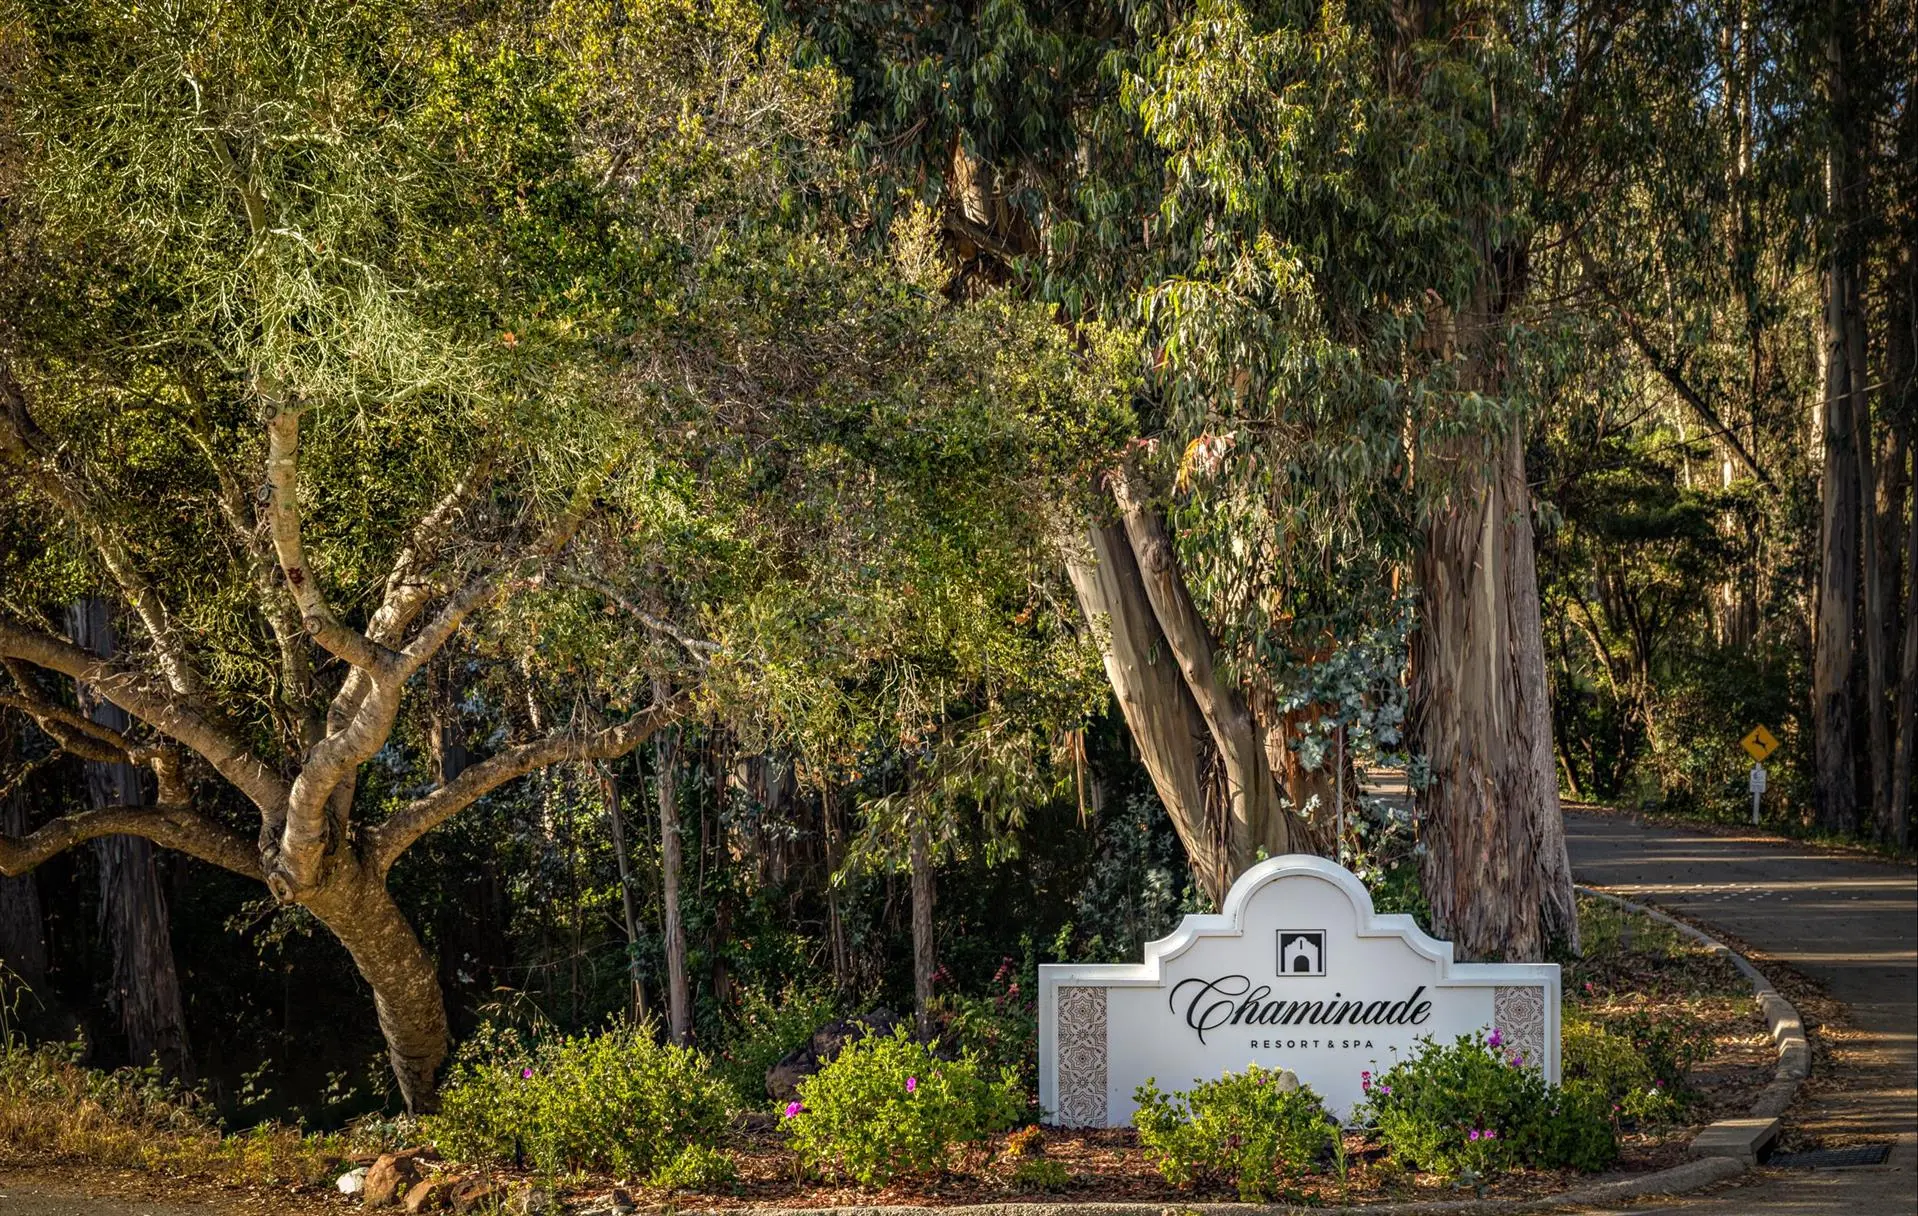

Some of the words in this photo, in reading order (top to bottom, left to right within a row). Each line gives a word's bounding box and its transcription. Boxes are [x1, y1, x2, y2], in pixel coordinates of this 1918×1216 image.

[1169, 975, 1433, 1046] Chaminade
[1250, 1039, 1320, 1049] RESORT
[1327, 1039, 1335, 1049] &
[1342, 1039, 1374, 1049] SPA
